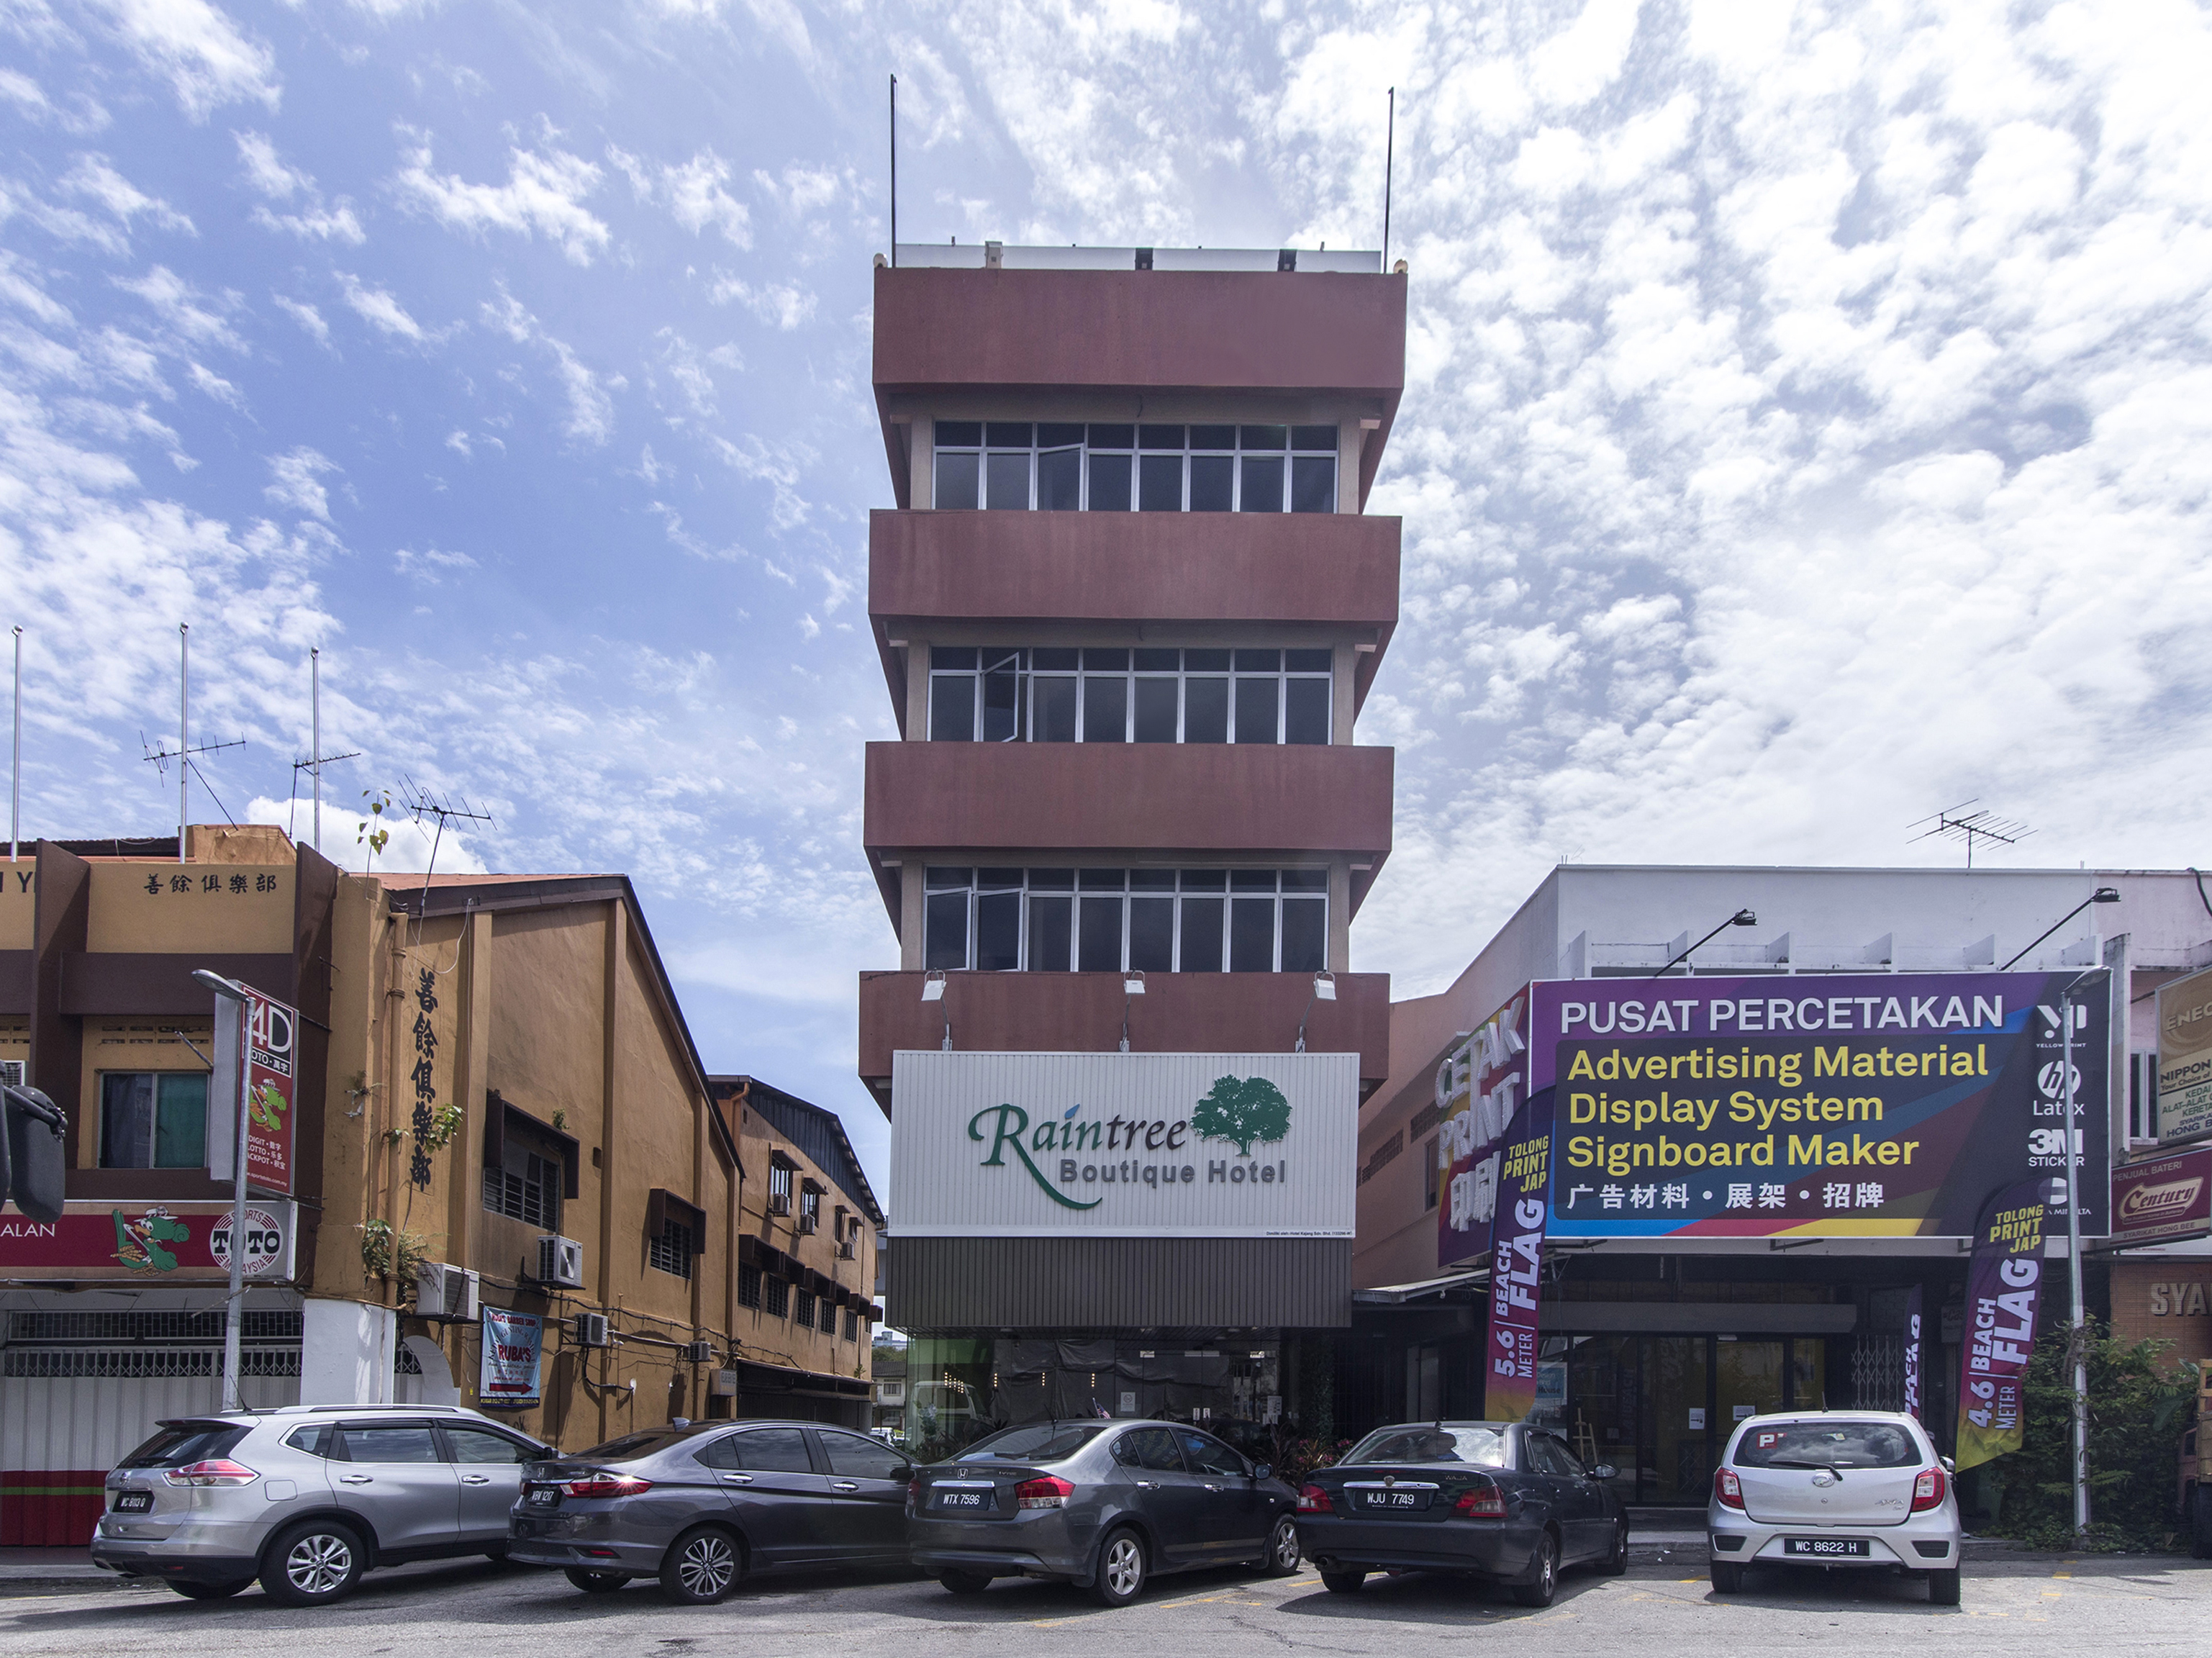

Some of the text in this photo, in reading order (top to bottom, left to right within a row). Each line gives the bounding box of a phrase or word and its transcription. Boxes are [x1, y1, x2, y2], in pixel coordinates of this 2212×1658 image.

[144, 873, 277, 894] 善餘俱樂部
[1561, 995, 2003, 1034] PUSAT PERCETAKAN
[252, 1050, 269, 1064] OTO
[1435, 996, 1526, 1113] CETAK
[1567, 1043, 1988, 1087] Advertising Material
[2160, 1059, 2211, 1083] NIPPON
[2161, 1082, 2177, 1091] Your
[2178, 1074, 2202, 1086] Choice
[2162, 1094, 2207, 1114] ALAT-ALAT
[2185, 1084, 2211, 1100] KEDAI
[1570, 1091, 1883, 1131] Display System
[2033, 1100, 2085, 1115] Latx
[1438, 1072, 1520, 1170] PRINT
[2167, 1123, 2200, 1138] HONG
[1509, 1135, 1549, 1159] TOLONG
[2028, 1128, 2083, 1155] 3M
[248, 1153, 271, 1164] CKPOT
[967, 1103, 1187, 1210] Raintree
[1503, 1151, 1548, 1180] PRINT
[1567, 1133, 1920, 1177] Signboard Maker
[2028, 1156, 2085, 1167] STICKR
[1060, 1159, 1285, 1189] Boutique Hotel
[1520, 1171, 1547, 1194] JAP
[2113, 1161, 2182, 1182] PENJUAL BATERI
[1567, 1182, 1884, 1209] 广告材料 展架 招牌
[2123, 1187, 2195, 1215] Century
[1995, 1204, 2044, 1225] TOLONG
[213, 1231, 281, 1254] TTO
[1990, 1217, 2043, 1243] PRINT
[2123, 1228, 2157, 1238] SYARIKAT
[2157, 1225, 2179, 1233] HONG
[1509, 1198, 1545, 1311] FLAG
[2010, 1234, 2041, 1254] JAP
[222, 1258, 268, 1274] MAYSIA
[1495, 1240, 1513, 1317] BEACH
[1992, 1259, 2039, 1364] FLAG
[2150, 1282, 2212, 1316] SYA
[1971, 1297, 1997, 1371] BEACH
[1495, 1330, 1516, 1378] 5.6
[1518, 1333, 1533, 1379] METER
[1968, 1381, 1995, 1428] 4.6
[1995, 1385, 2016, 1431] METER
[943, 1493, 980, 1505] WTX 7596
[1367, 1492, 1415, 1505] WJU 7749
[1795, 1541, 1857, 1553] WC 8622 H
